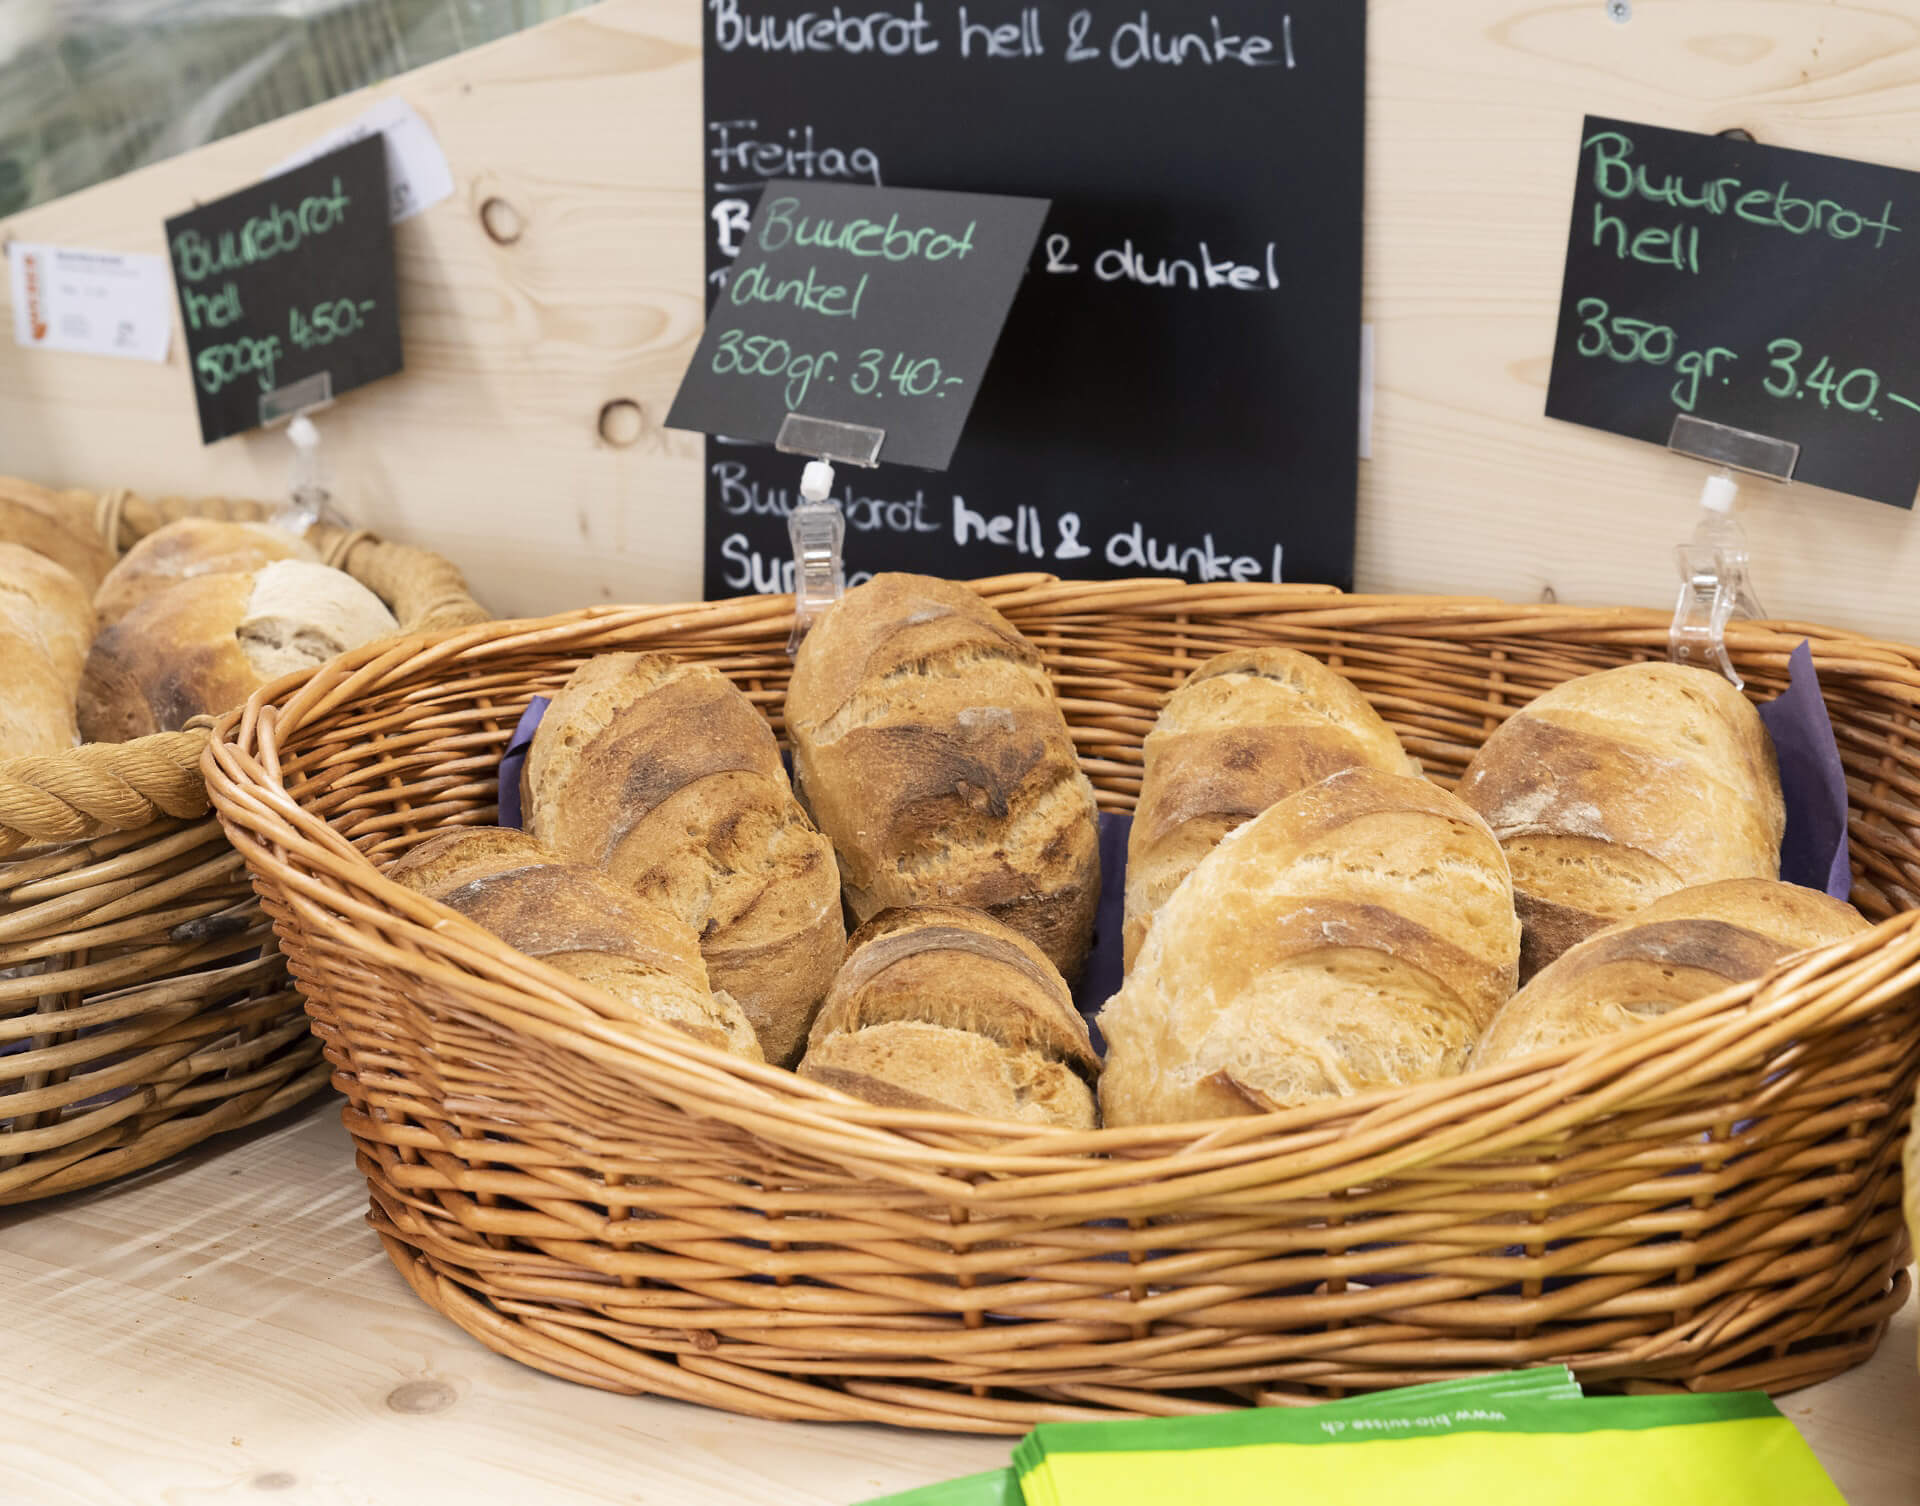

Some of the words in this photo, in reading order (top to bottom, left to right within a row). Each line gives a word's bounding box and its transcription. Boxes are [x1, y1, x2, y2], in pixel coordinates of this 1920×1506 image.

[709, 0, 939, 55] Buurebrot
[959, 5, 1045, 58] hell
[1065, 13, 1100, 61] &
[1109, 14, 1294, 68] dunkel
[709, 119, 881, 187] Freitag
[1583, 131, 1902, 249] Buurebrot
[174, 175, 349, 280] Buurebrot
[759, 196, 977, 262] Buurebrot
[1594, 201, 1699, 275] hell
[731, 261, 869, 320] dunkel
[1094, 239, 1279, 290] dunkel
[183, 282, 243, 330] hell
[953, 495, 1045, 559] hell
[1054, 512, 1093, 559] &
[1105, 521, 1283, 584] dunkel
